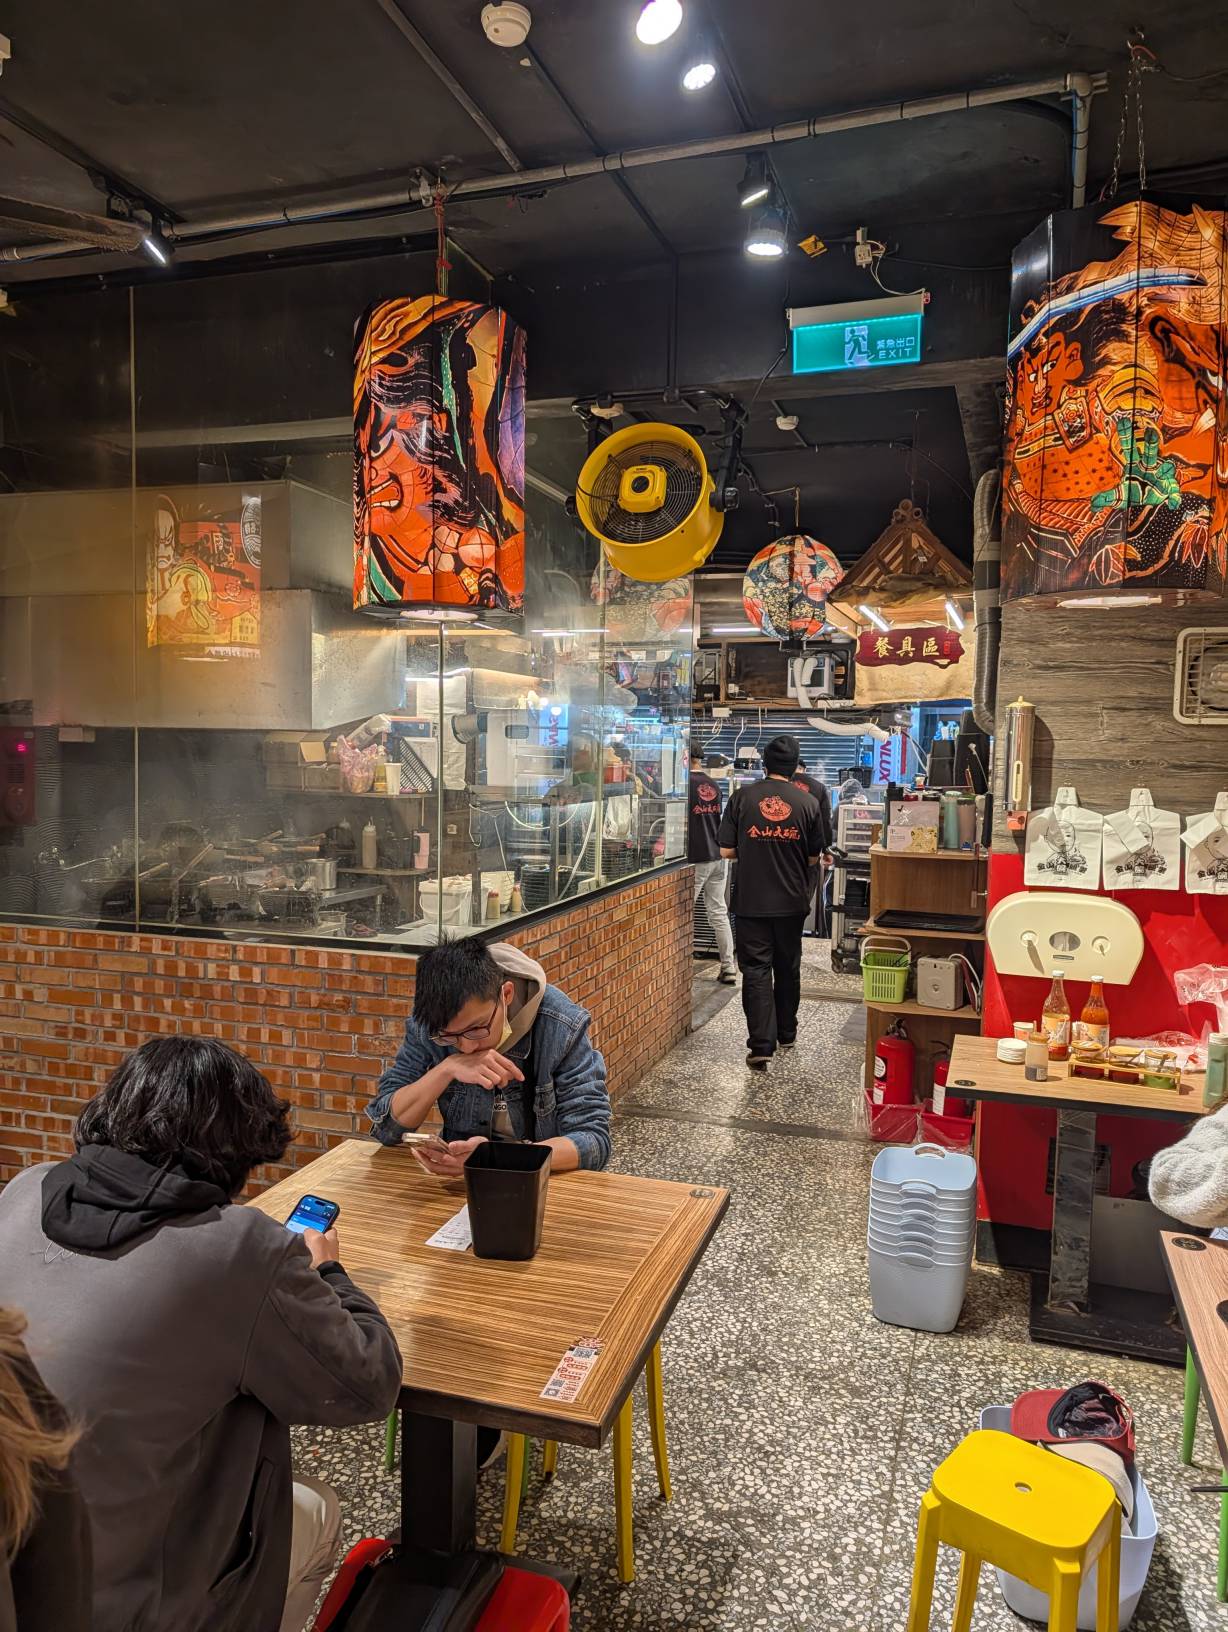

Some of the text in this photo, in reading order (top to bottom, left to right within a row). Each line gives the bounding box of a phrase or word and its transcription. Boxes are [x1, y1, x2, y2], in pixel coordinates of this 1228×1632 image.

[876, 336, 914, 350] 緊急出口
[879, 348, 912, 359] EXIT
[872, 635, 940, 658] 餐具區
